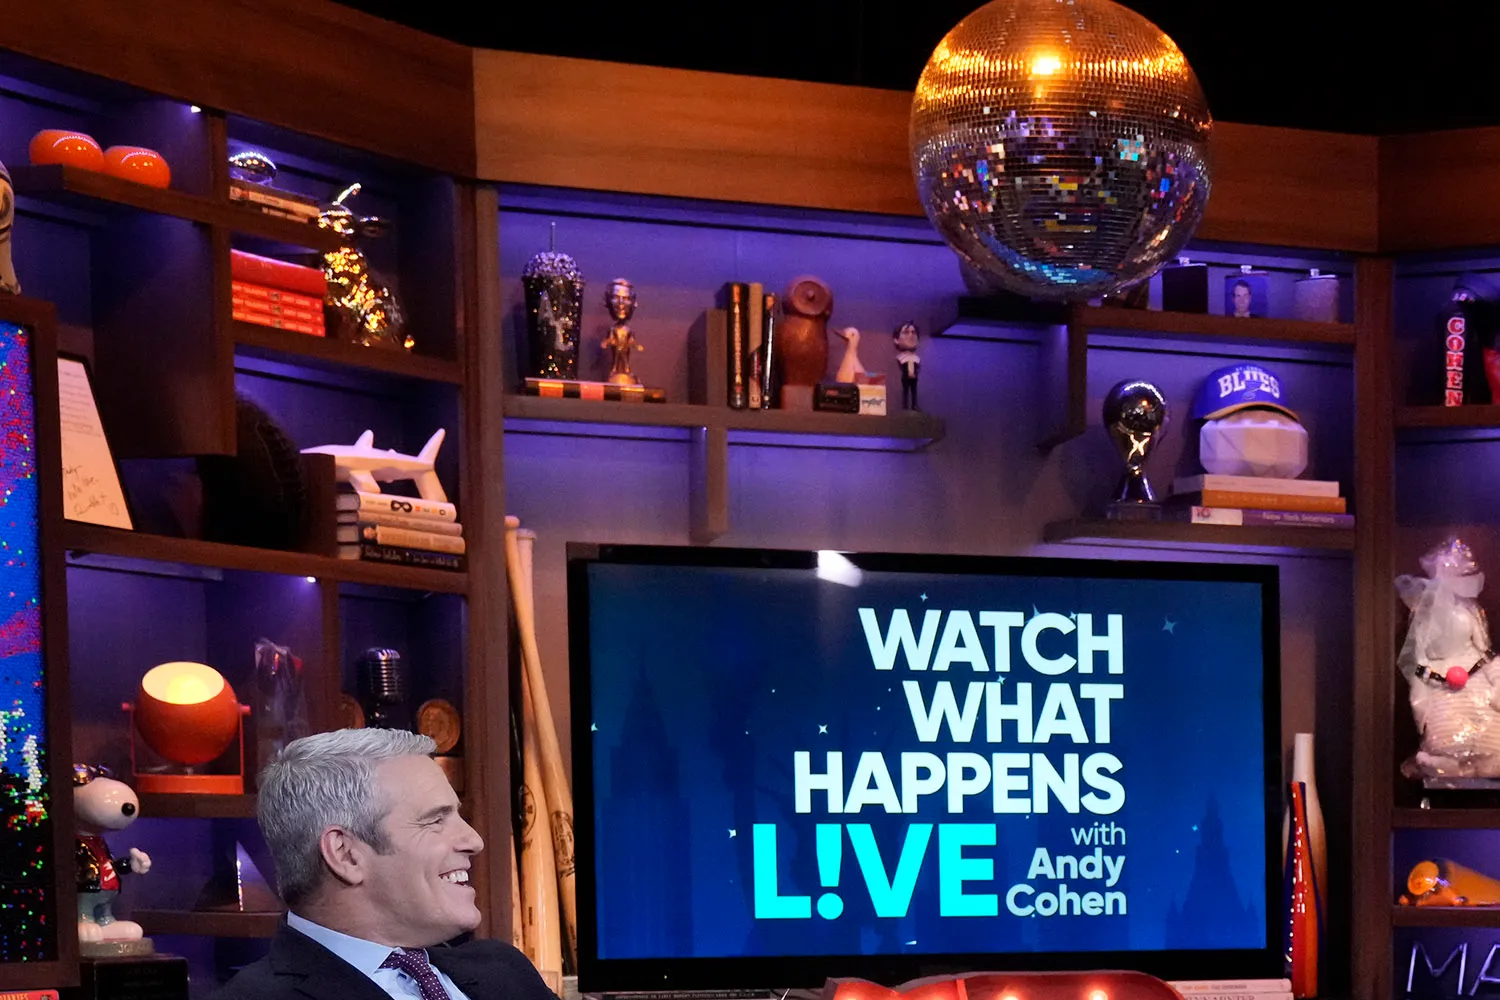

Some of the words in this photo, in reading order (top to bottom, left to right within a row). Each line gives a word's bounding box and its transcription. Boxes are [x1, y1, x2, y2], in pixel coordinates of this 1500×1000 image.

[858, 607, 1124, 676] WATCH
[902, 680, 1124, 744] WHAT
[793, 750, 1126, 815] HAPPENS
[1070, 821, 1126, 846] with
[752, 823, 999, 920] L!VE
[1026, 847, 1126, 887] Andy
[1005, 884, 1128, 917] Cohen
